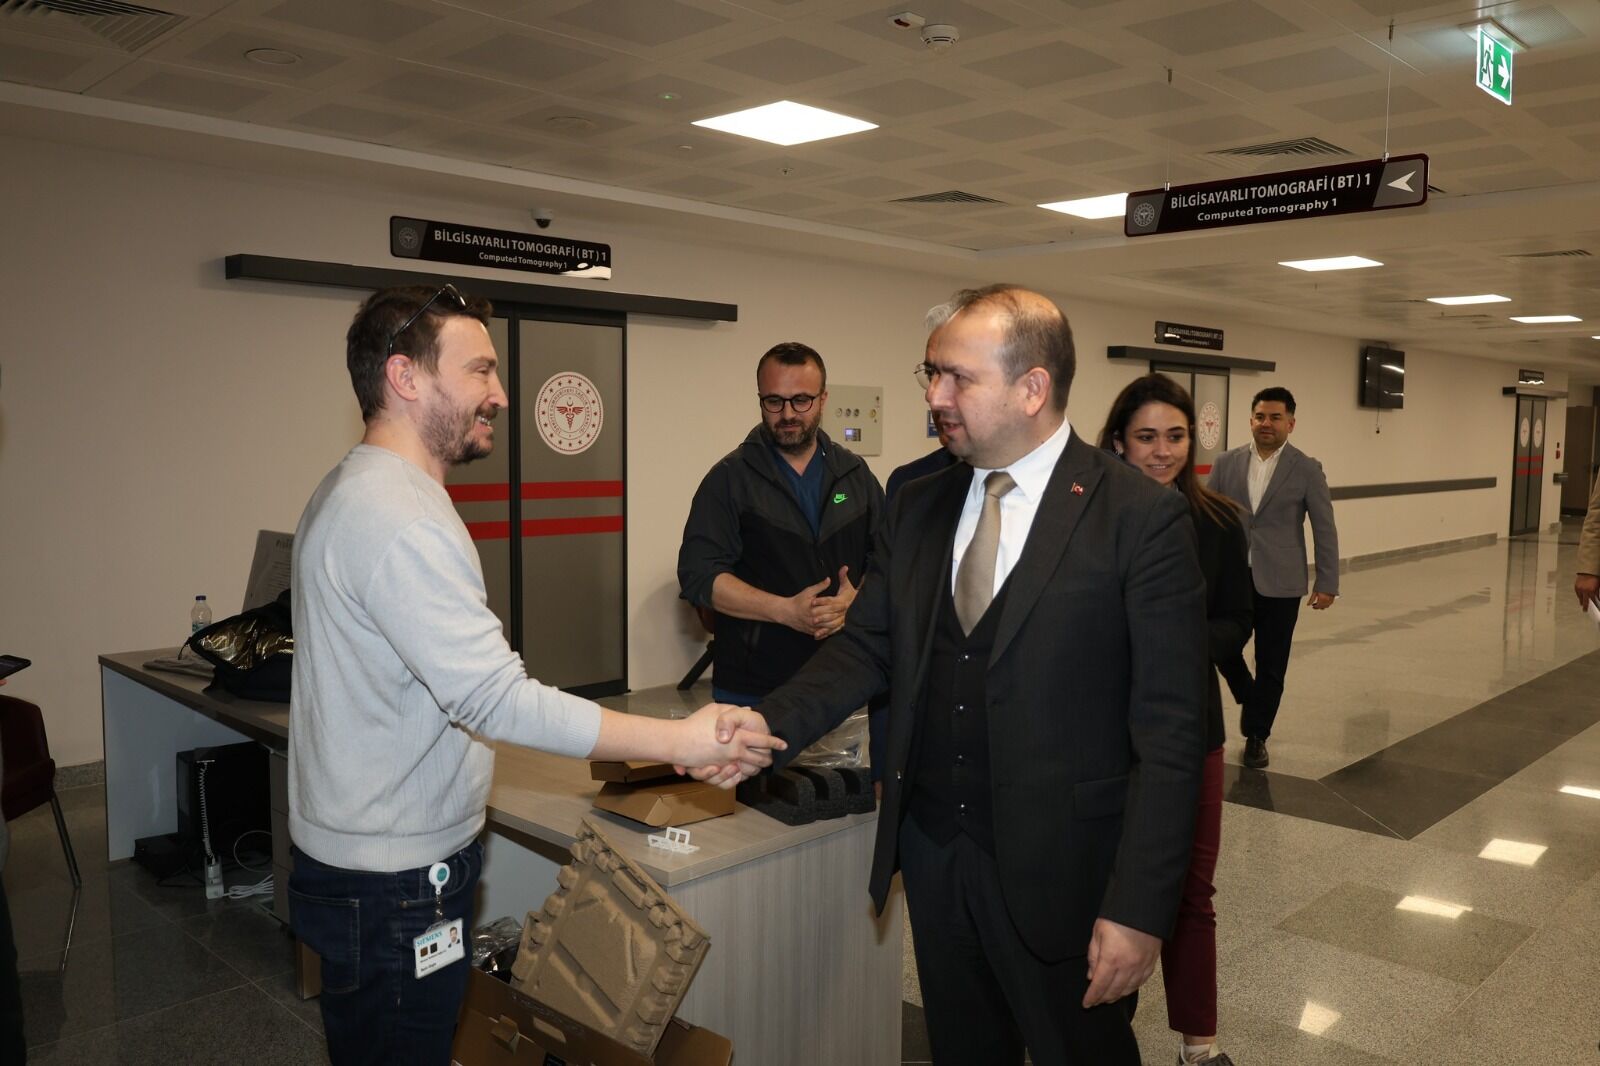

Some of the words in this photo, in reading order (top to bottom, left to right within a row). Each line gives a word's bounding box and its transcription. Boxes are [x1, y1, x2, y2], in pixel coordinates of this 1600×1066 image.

[1171, 188, 1248, 209] BİLGİSAYARLI
[1250, 176, 1328, 199] TOMOGRAFİ
[1364, 173, 1371, 185] 1
[1197, 207, 1253, 221] Computed
[1255, 200, 1329, 213] Tomography
[1332, 198, 1337, 206] 1
[434, 229, 510, 248] BİLGİSAYARLI
[511, 239, 575, 256] TOMOGRAFİ
[601, 252, 607, 261] 1
[479, 252, 517, 263] Computed
[518, 256, 564, 270] Tomography
